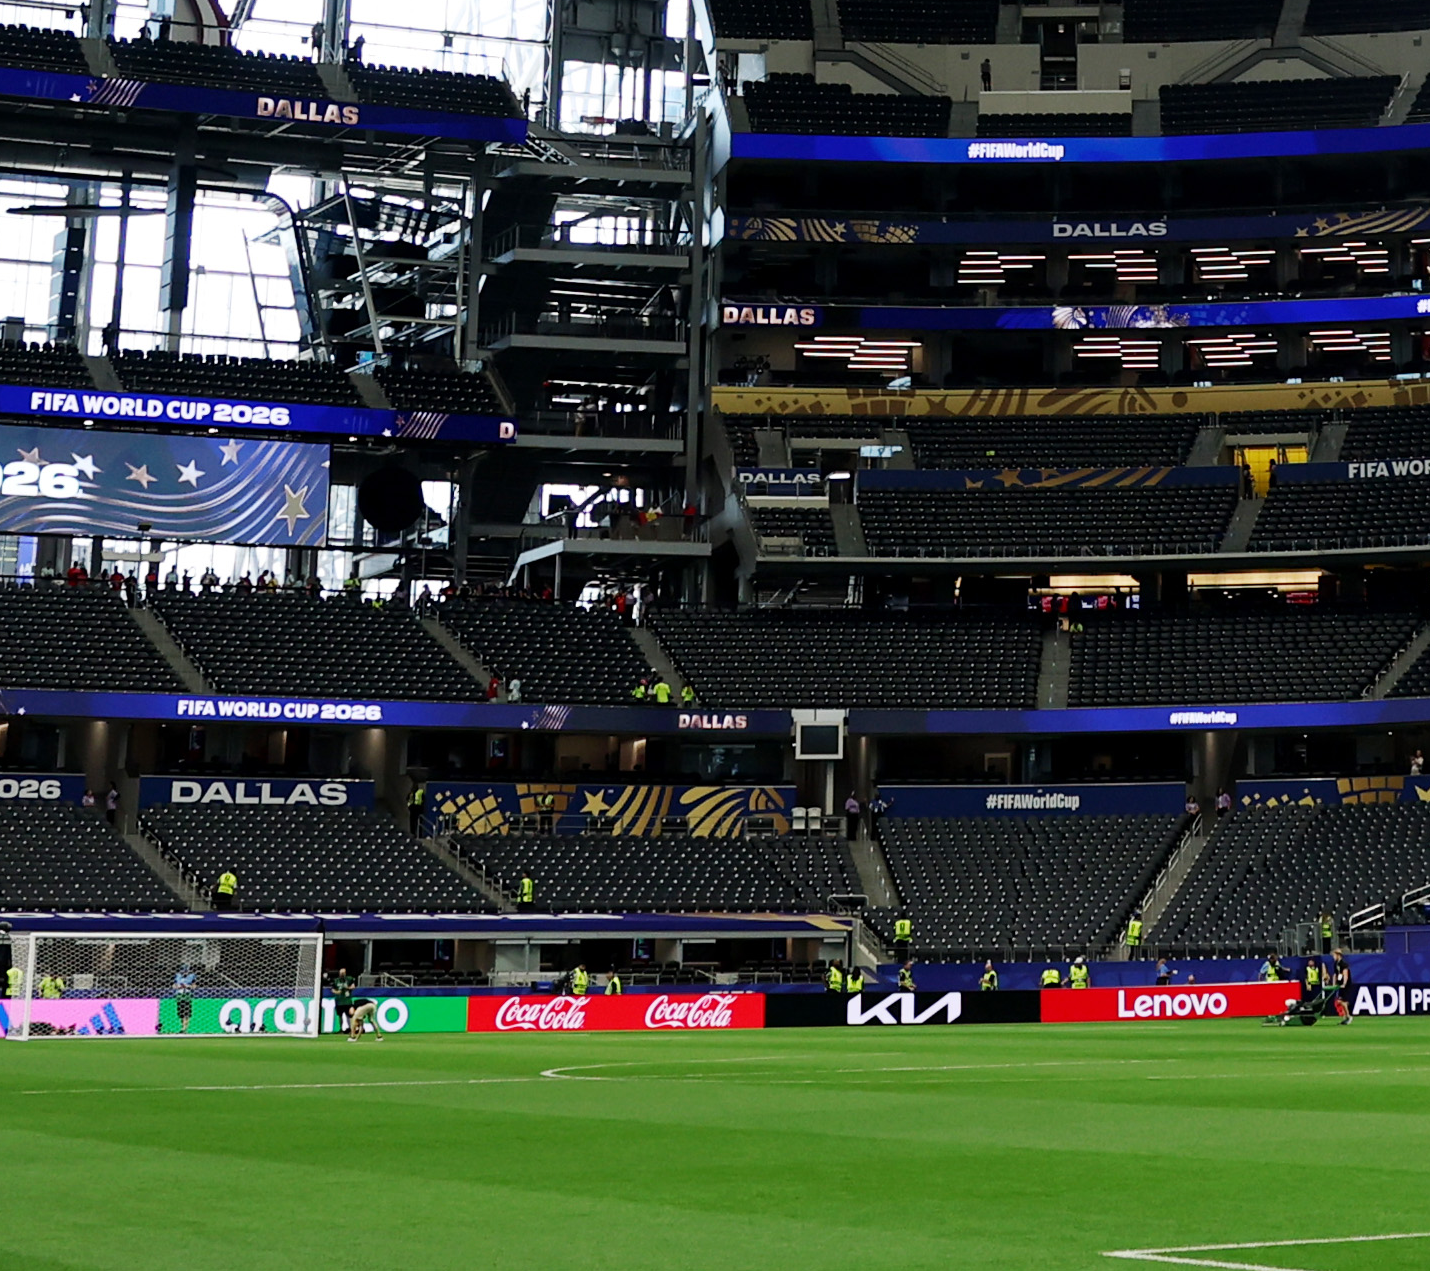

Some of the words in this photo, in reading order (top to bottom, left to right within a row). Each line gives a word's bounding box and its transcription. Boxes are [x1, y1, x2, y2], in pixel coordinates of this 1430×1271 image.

[258, 98, 358, 124] DALLAS
[968, 142, 1064, 160] #FIFAWorldCup
[1054, 223, 1167, 236] DALLAS
[724, 307, 814, 324] DALLAS
[31, 392, 79, 412] FIFA
[83, 395, 163, 417] WORLD
[167, 401, 211, 420] CUP
[213, 404, 289, 425] 2026
[739, 472, 822, 485] DALLAS
[1349, 462, 1389, 478] FIFA
[178, 700, 215, 715] FIFA
[218, 701, 281, 717] WORLD
[284, 703, 319, 718] CUP
[321, 704, 381, 720] 2026
[1170, 711, 1236, 724] #FIFAWorldCup
[679, 714, 746, 728] DALLAS
[172, 781, 347, 805] DALLAS
[986, 793, 1079, 810] #FIFAWorldCup
[1118, 990, 1227, 1017] Lenovo
[1353, 986, 1405, 1014] ADI
[494, 996, 591, 1030] Coca-Cola
[645, 994, 738, 1028] Coca-Cola
